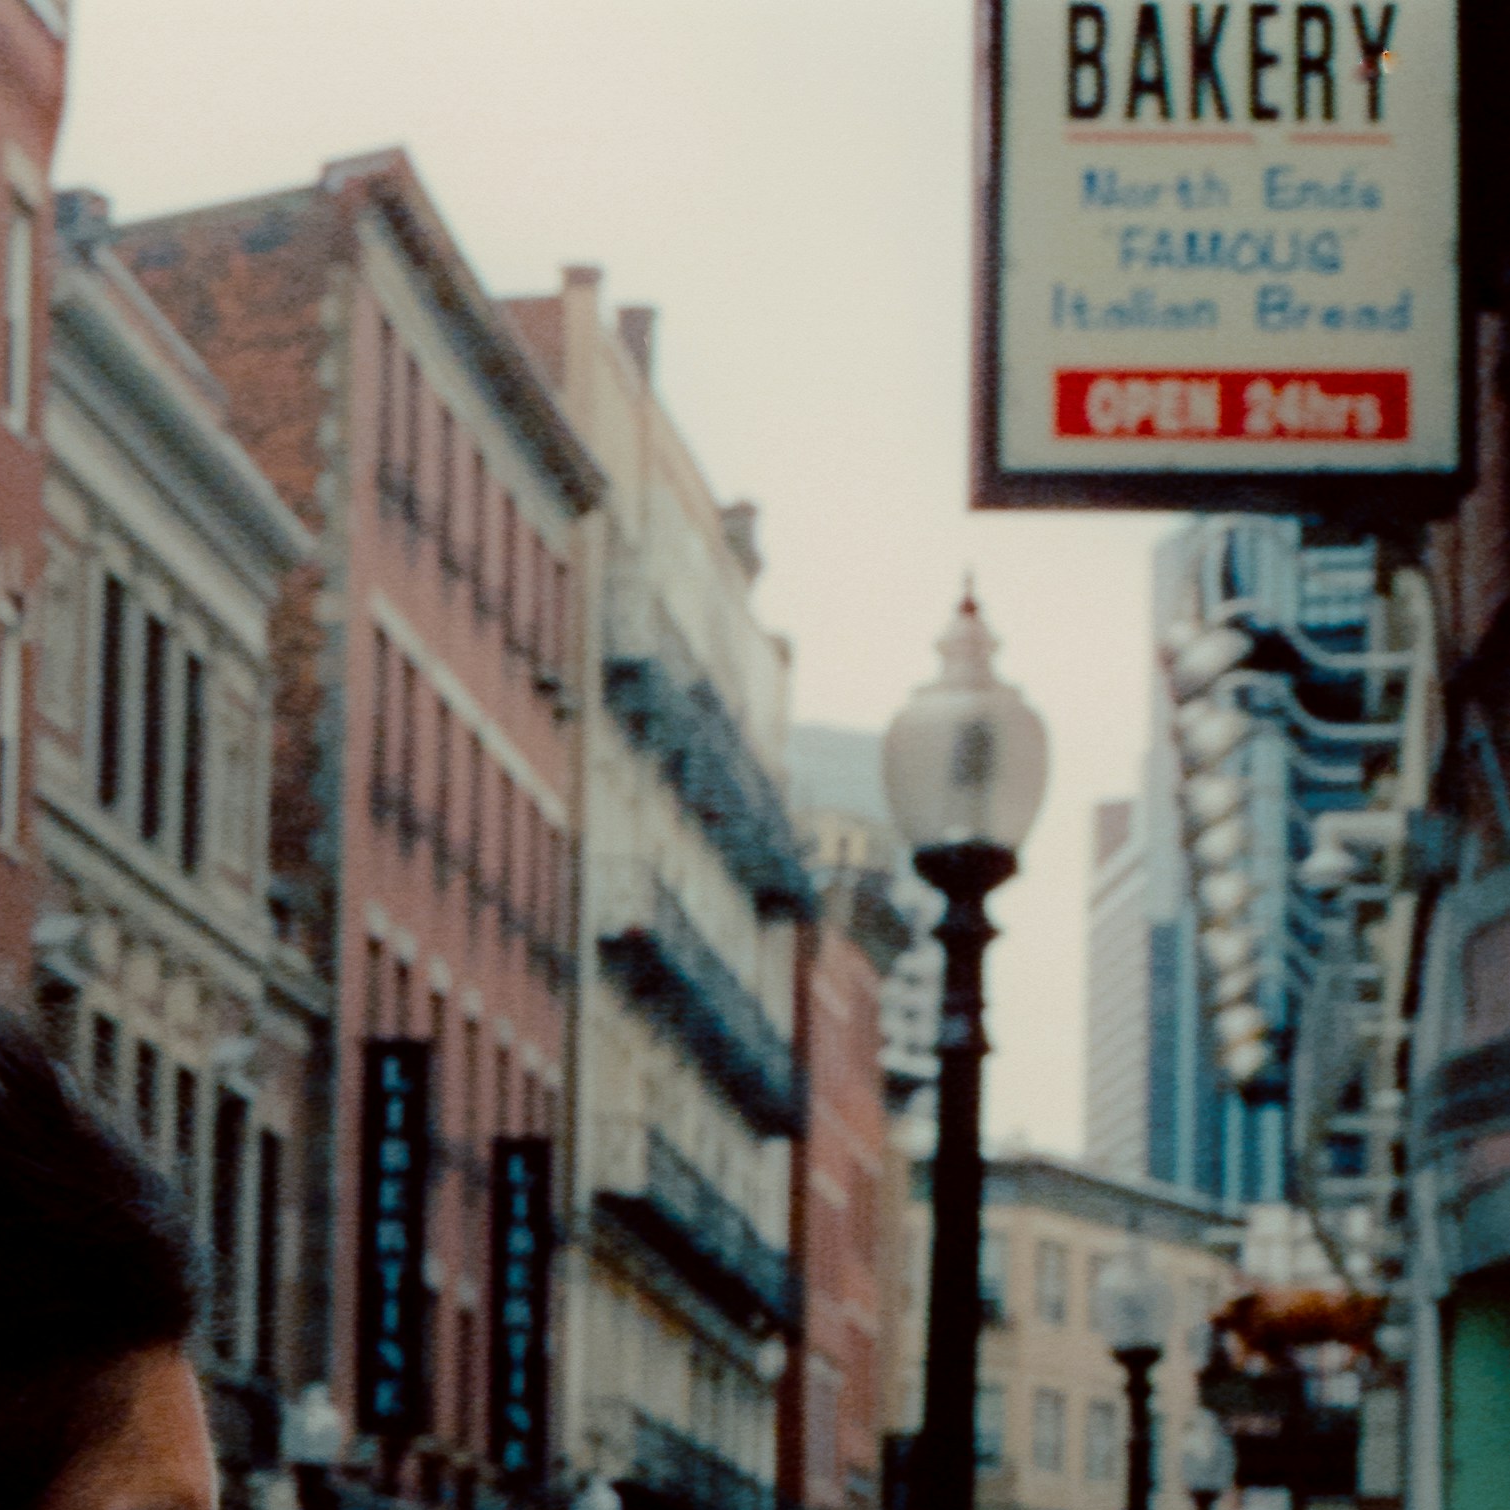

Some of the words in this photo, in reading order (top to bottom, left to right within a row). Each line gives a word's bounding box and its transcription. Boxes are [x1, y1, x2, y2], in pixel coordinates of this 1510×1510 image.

[1067, 3, 1395, 122] BAKERY
[1081, 165, 1232, 210] North
[1051, 282, 1218, 330] Italian
[1255, 284, 1413, 333] Bread
[1085, 376, 1221, 435] OPEN
